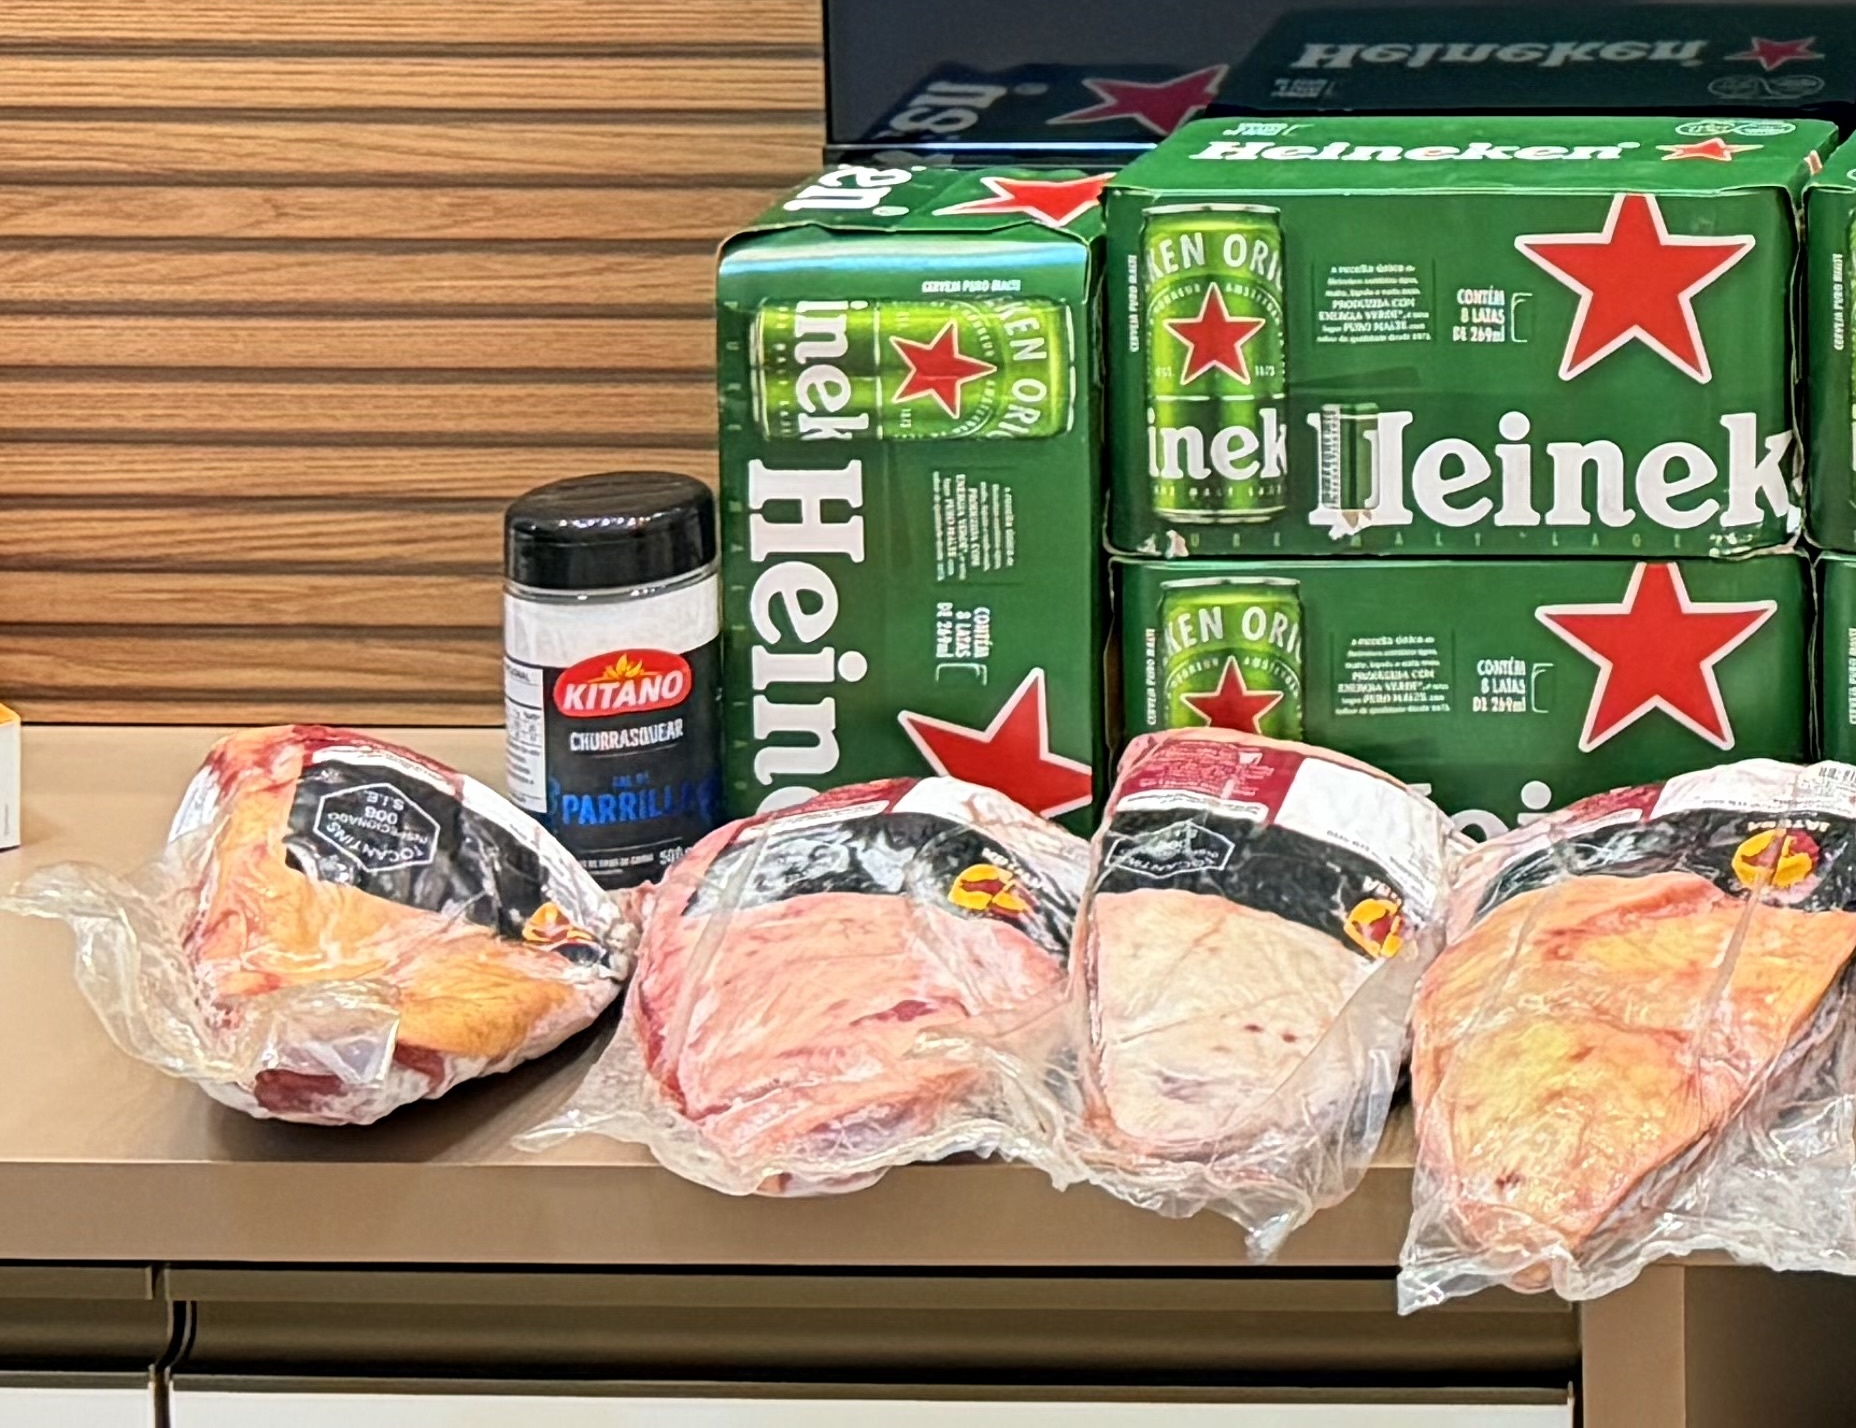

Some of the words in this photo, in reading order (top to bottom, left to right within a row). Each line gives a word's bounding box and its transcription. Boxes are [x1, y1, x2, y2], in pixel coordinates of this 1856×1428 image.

[1189, 141, 1625, 162] Heineken
[1147, 407, 1287, 481] inek
[562, 669, 684, 711] KITANO
[569, 718, 684, 752] CHURRASQUEAR
[326, 821, 425, 863] TOCANTINS
